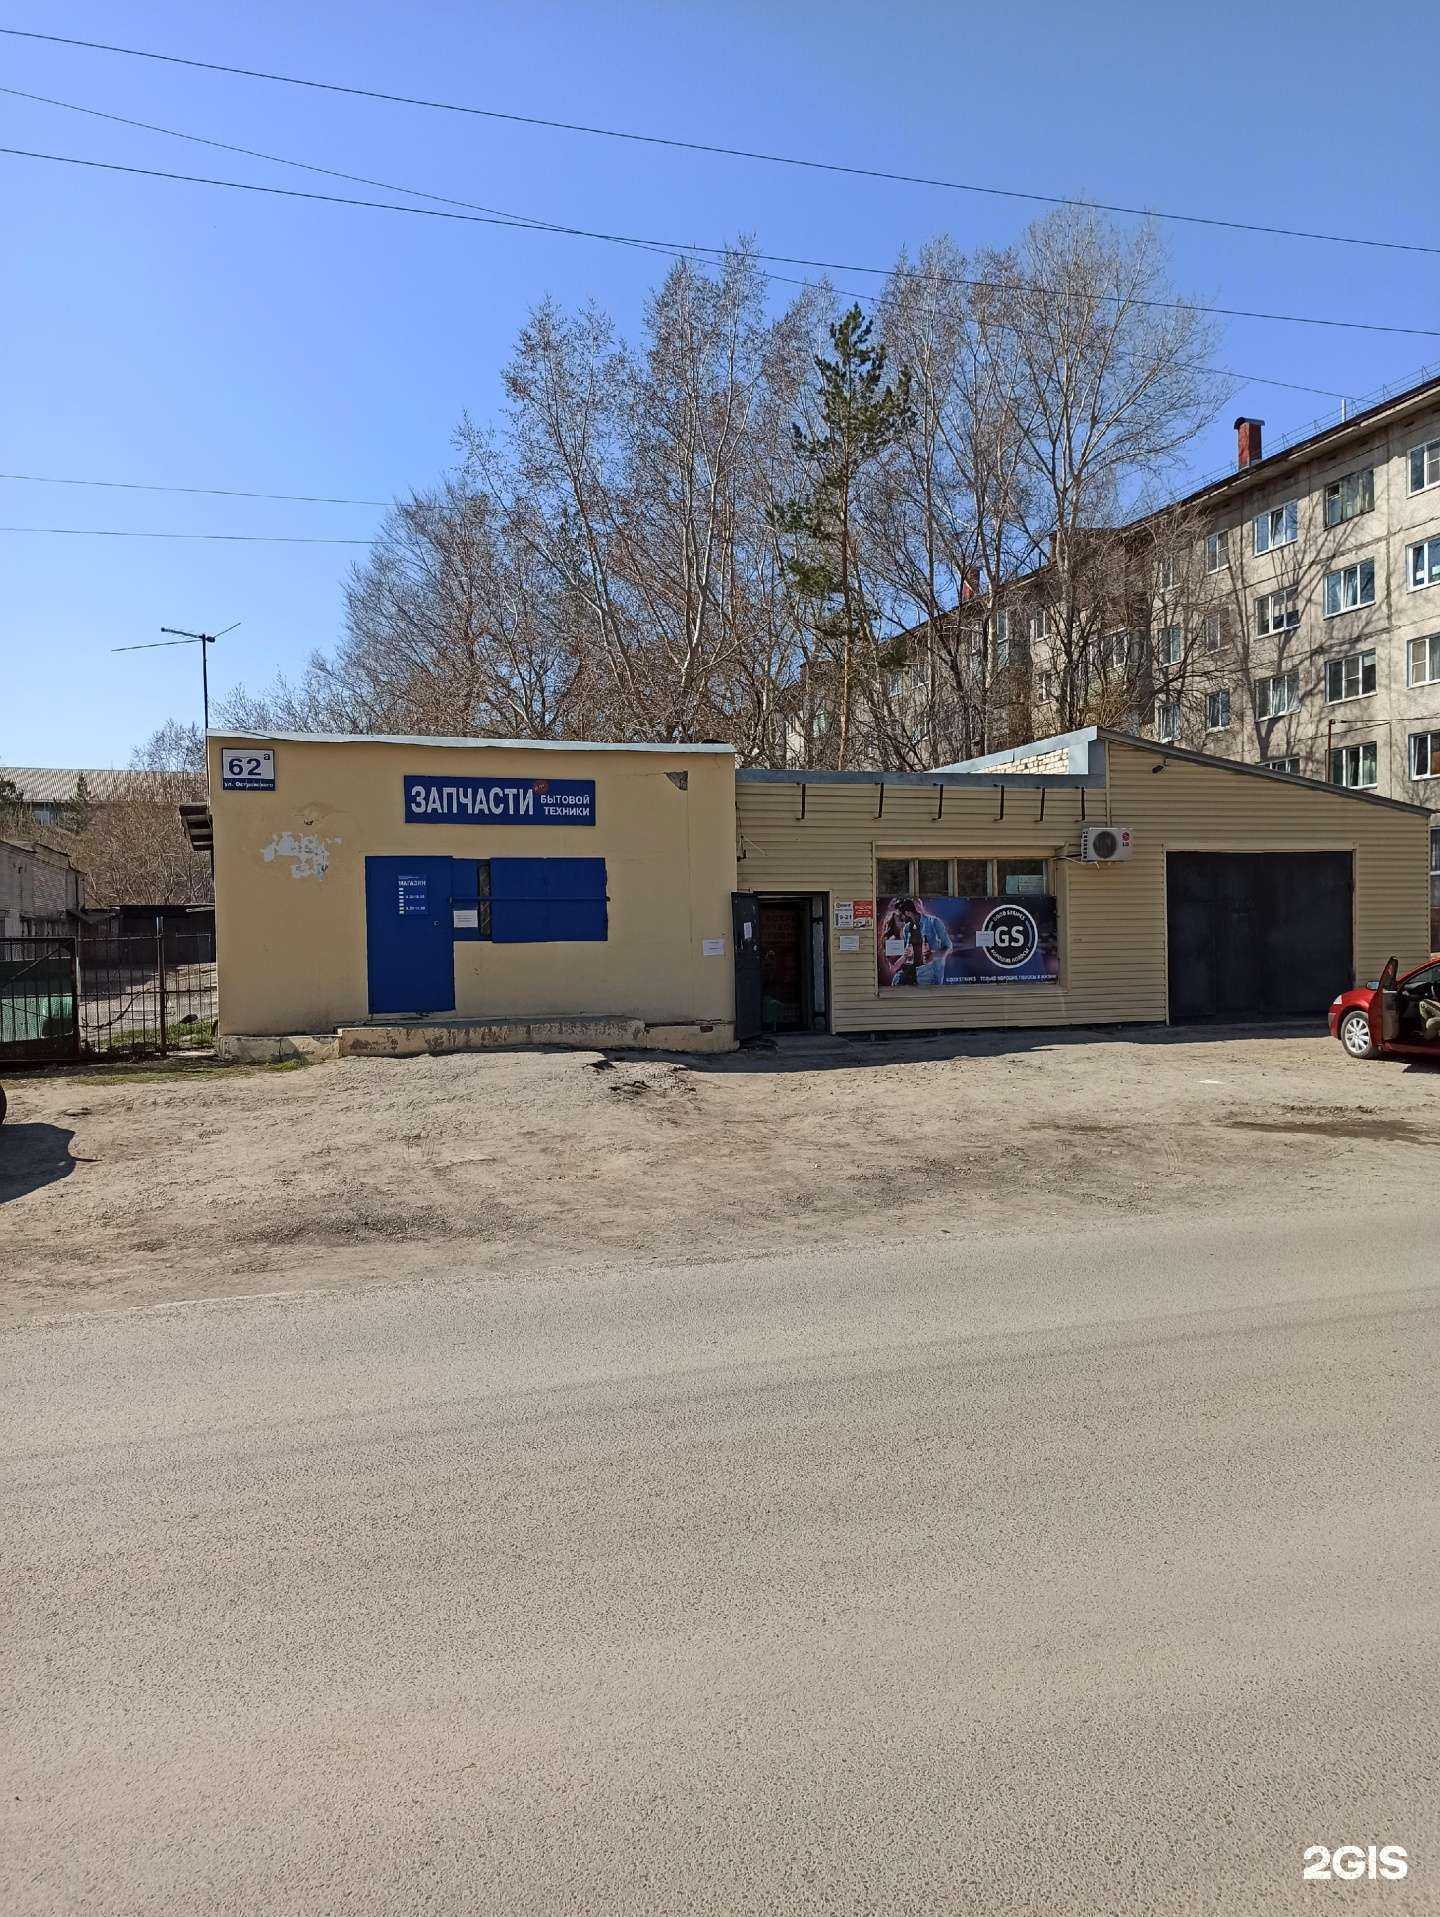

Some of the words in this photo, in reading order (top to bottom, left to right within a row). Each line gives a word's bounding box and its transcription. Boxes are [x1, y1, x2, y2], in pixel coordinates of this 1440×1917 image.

[411, 785, 534, 815] ЗАПЧАСТИ
[540, 794, 590, 804] БЫТОВОЙ
[543, 806, 590, 816] ТЕХНИКИ
[995, 925, 1024, 947] GS
